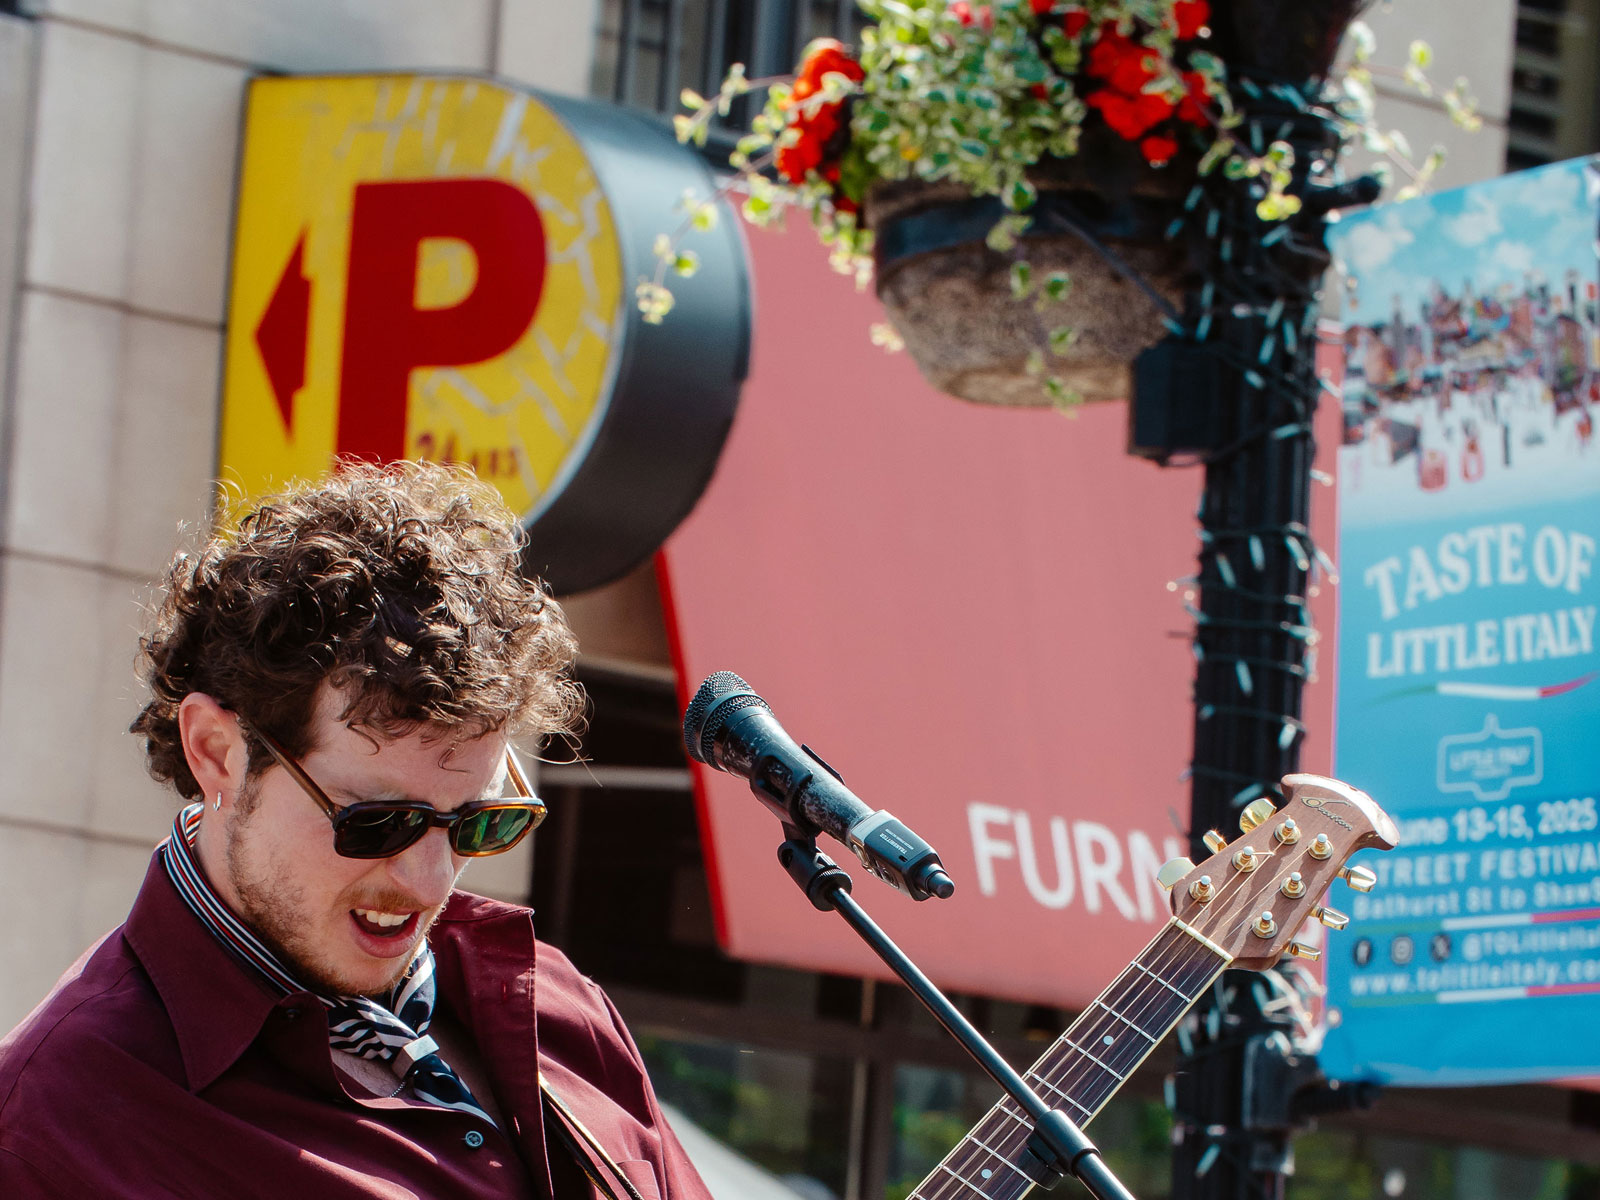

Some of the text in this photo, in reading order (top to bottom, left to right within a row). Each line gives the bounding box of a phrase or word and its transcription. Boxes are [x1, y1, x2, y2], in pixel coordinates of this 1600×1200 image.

[333, 177, 549, 471] P
[1363, 522, 1597, 621] TASTE OF
[1366, 604, 1598, 679] LITTLE ITALY
[1391, 797, 1598, 847] une 13-15, 2025
[1479, 841, 1600, 881] FESTIVA
[1353, 890, 1459, 921] Bathurst
[1500, 885, 1527, 912] to
[1350, 957, 1600, 997] www.tolittleitaly.co
